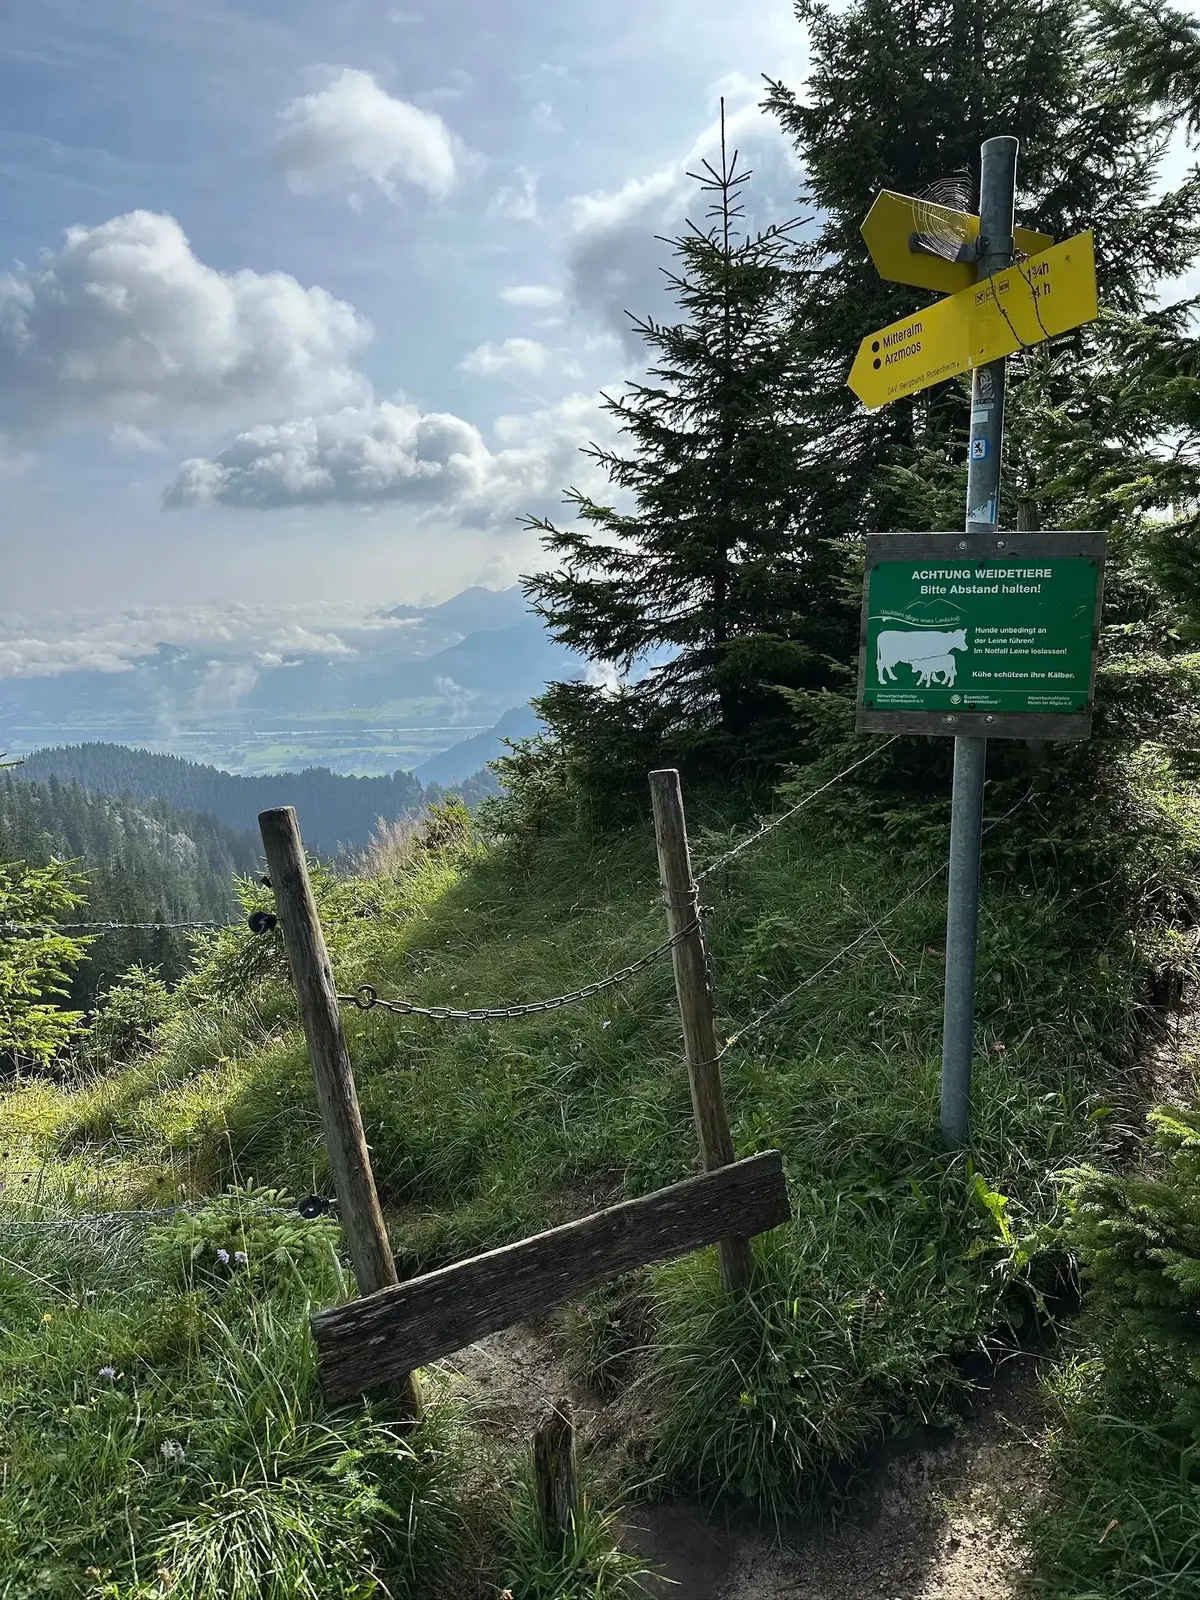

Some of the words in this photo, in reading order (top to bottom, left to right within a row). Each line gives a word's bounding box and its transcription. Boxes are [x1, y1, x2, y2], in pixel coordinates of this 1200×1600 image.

[882, 322, 923, 348] Mitteralm
[885, 341, 922, 366] Arzmoos
[887, 386, 898, 395] DAV
[899, 375, 925, 390] Bergbund
[926, 362, 957, 379] Rosenheim
[912, 570, 971, 580] ACHTUNG
[975, 568, 1052, 579] WEIDETIERE
[920, 585, 947, 595] Bitte
[949, 584, 999, 594] Abstand
[1002, 584, 1041, 594] halten!
[975, 626, 999, 634] Hunde
[1000, 626, 1036, 635] unbedingt
[1047, 671, 1075, 679] Kälber.
